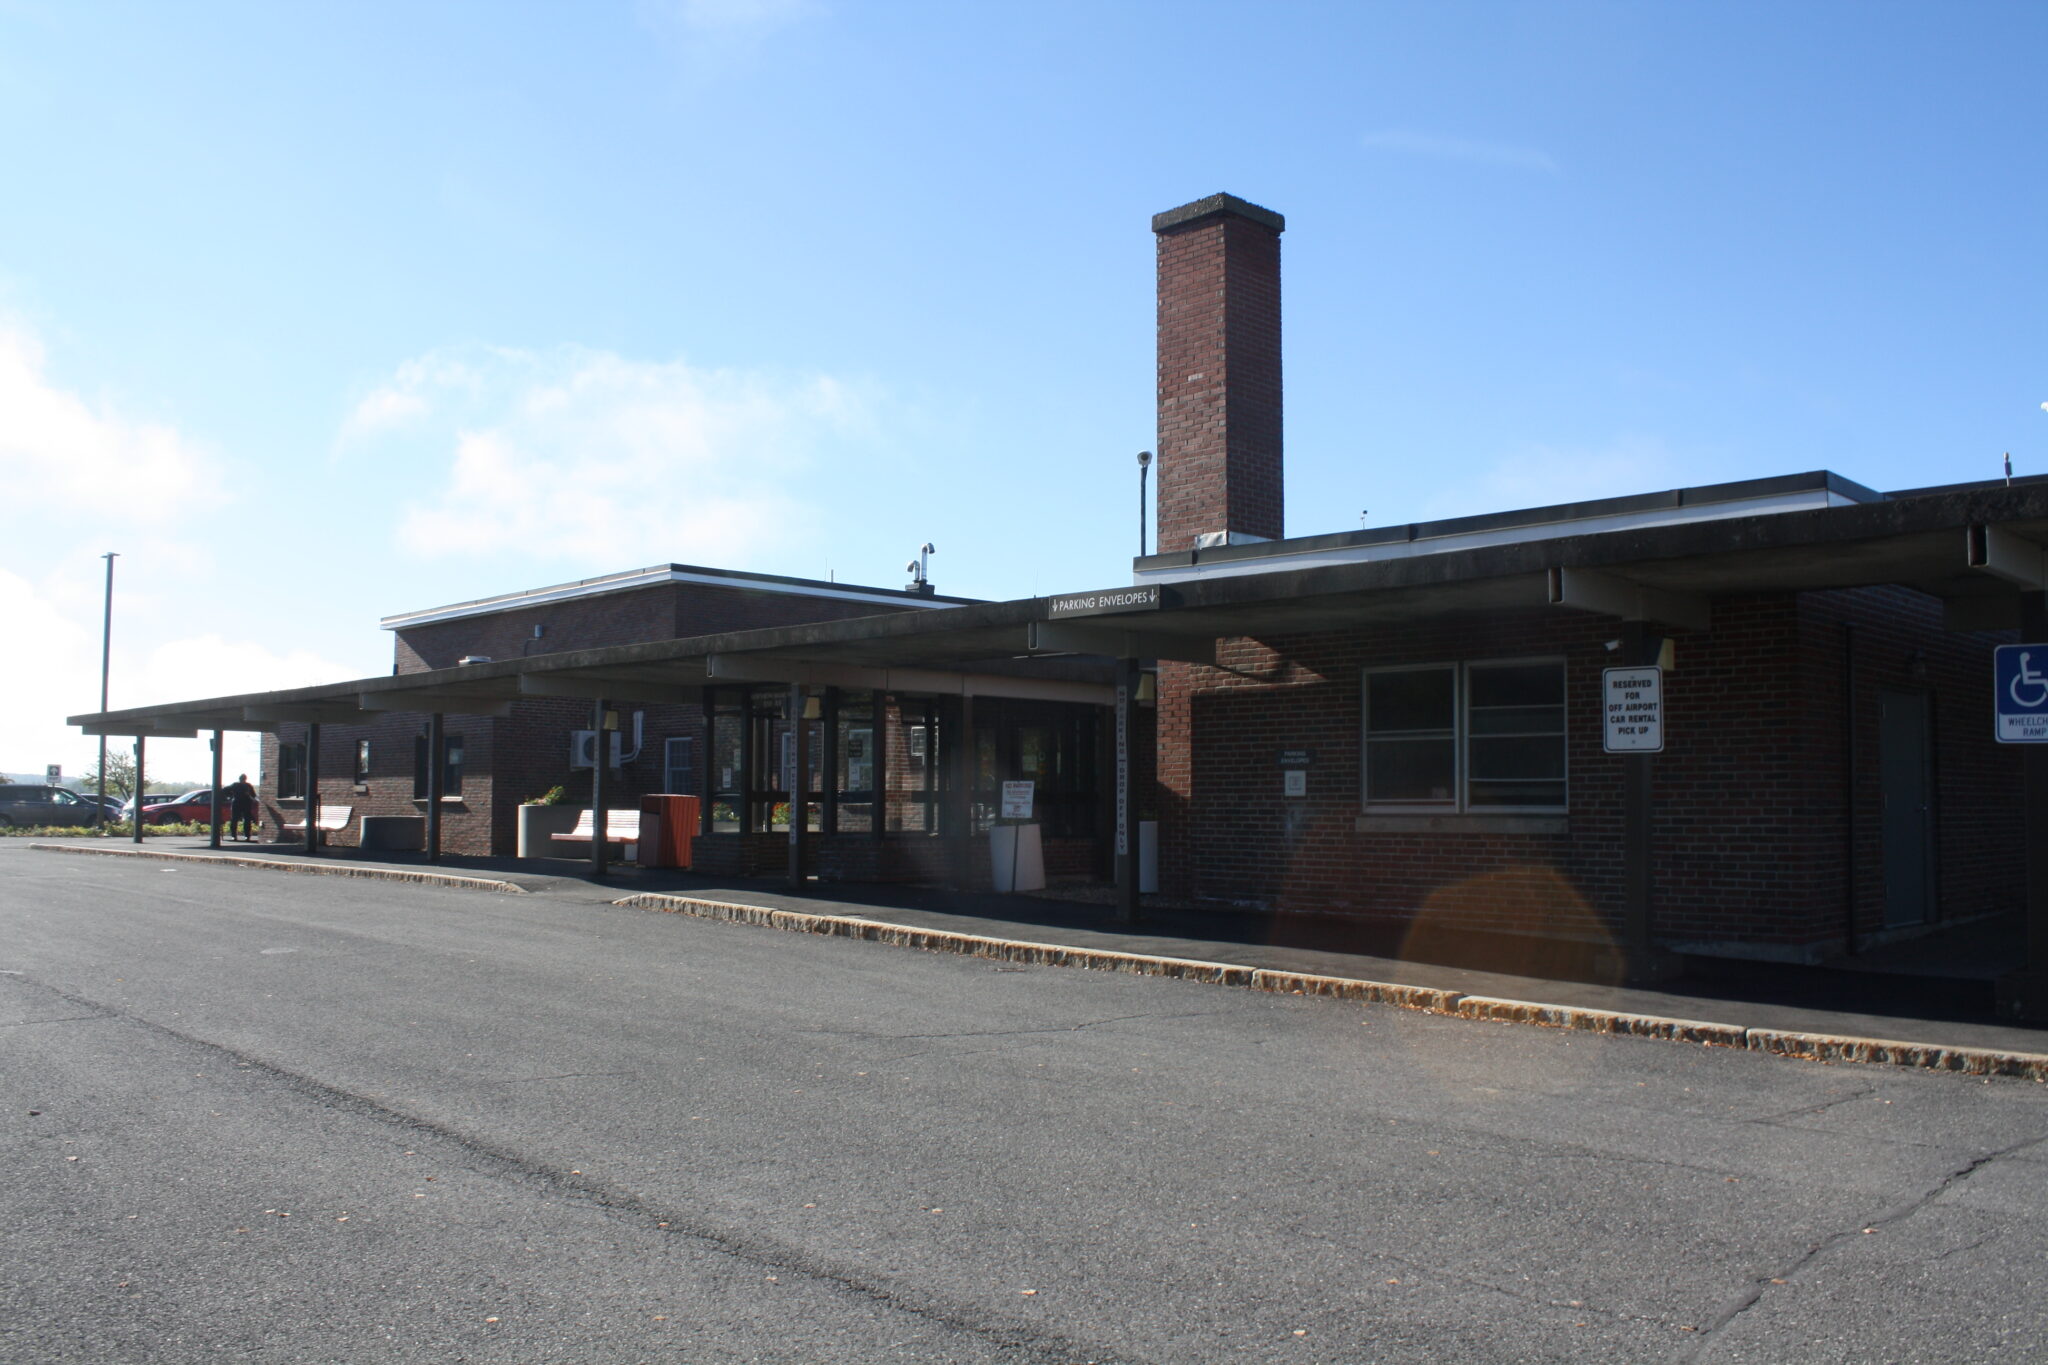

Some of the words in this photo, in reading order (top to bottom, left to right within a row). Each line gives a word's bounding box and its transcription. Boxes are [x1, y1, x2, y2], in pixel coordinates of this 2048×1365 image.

[1059, 598, 1095, 611] PARKING
[1099, 592, 1147, 607] ENVELOPES
[1613, 680, 1652, 688] RESERVED
[1625, 692, 1640, 700] FOR
[1608, 704, 1623, 712] OFF
[1625, 703, 1657, 711] AIRPORT
[1610, 715, 1625, 723] CAR
[1629, 715, 1656, 723] RENTAL
[1618, 727, 1635, 735] PICK
[1638, 727, 1648, 735] UP
[2023, 728, 2047, 736] RAMP
